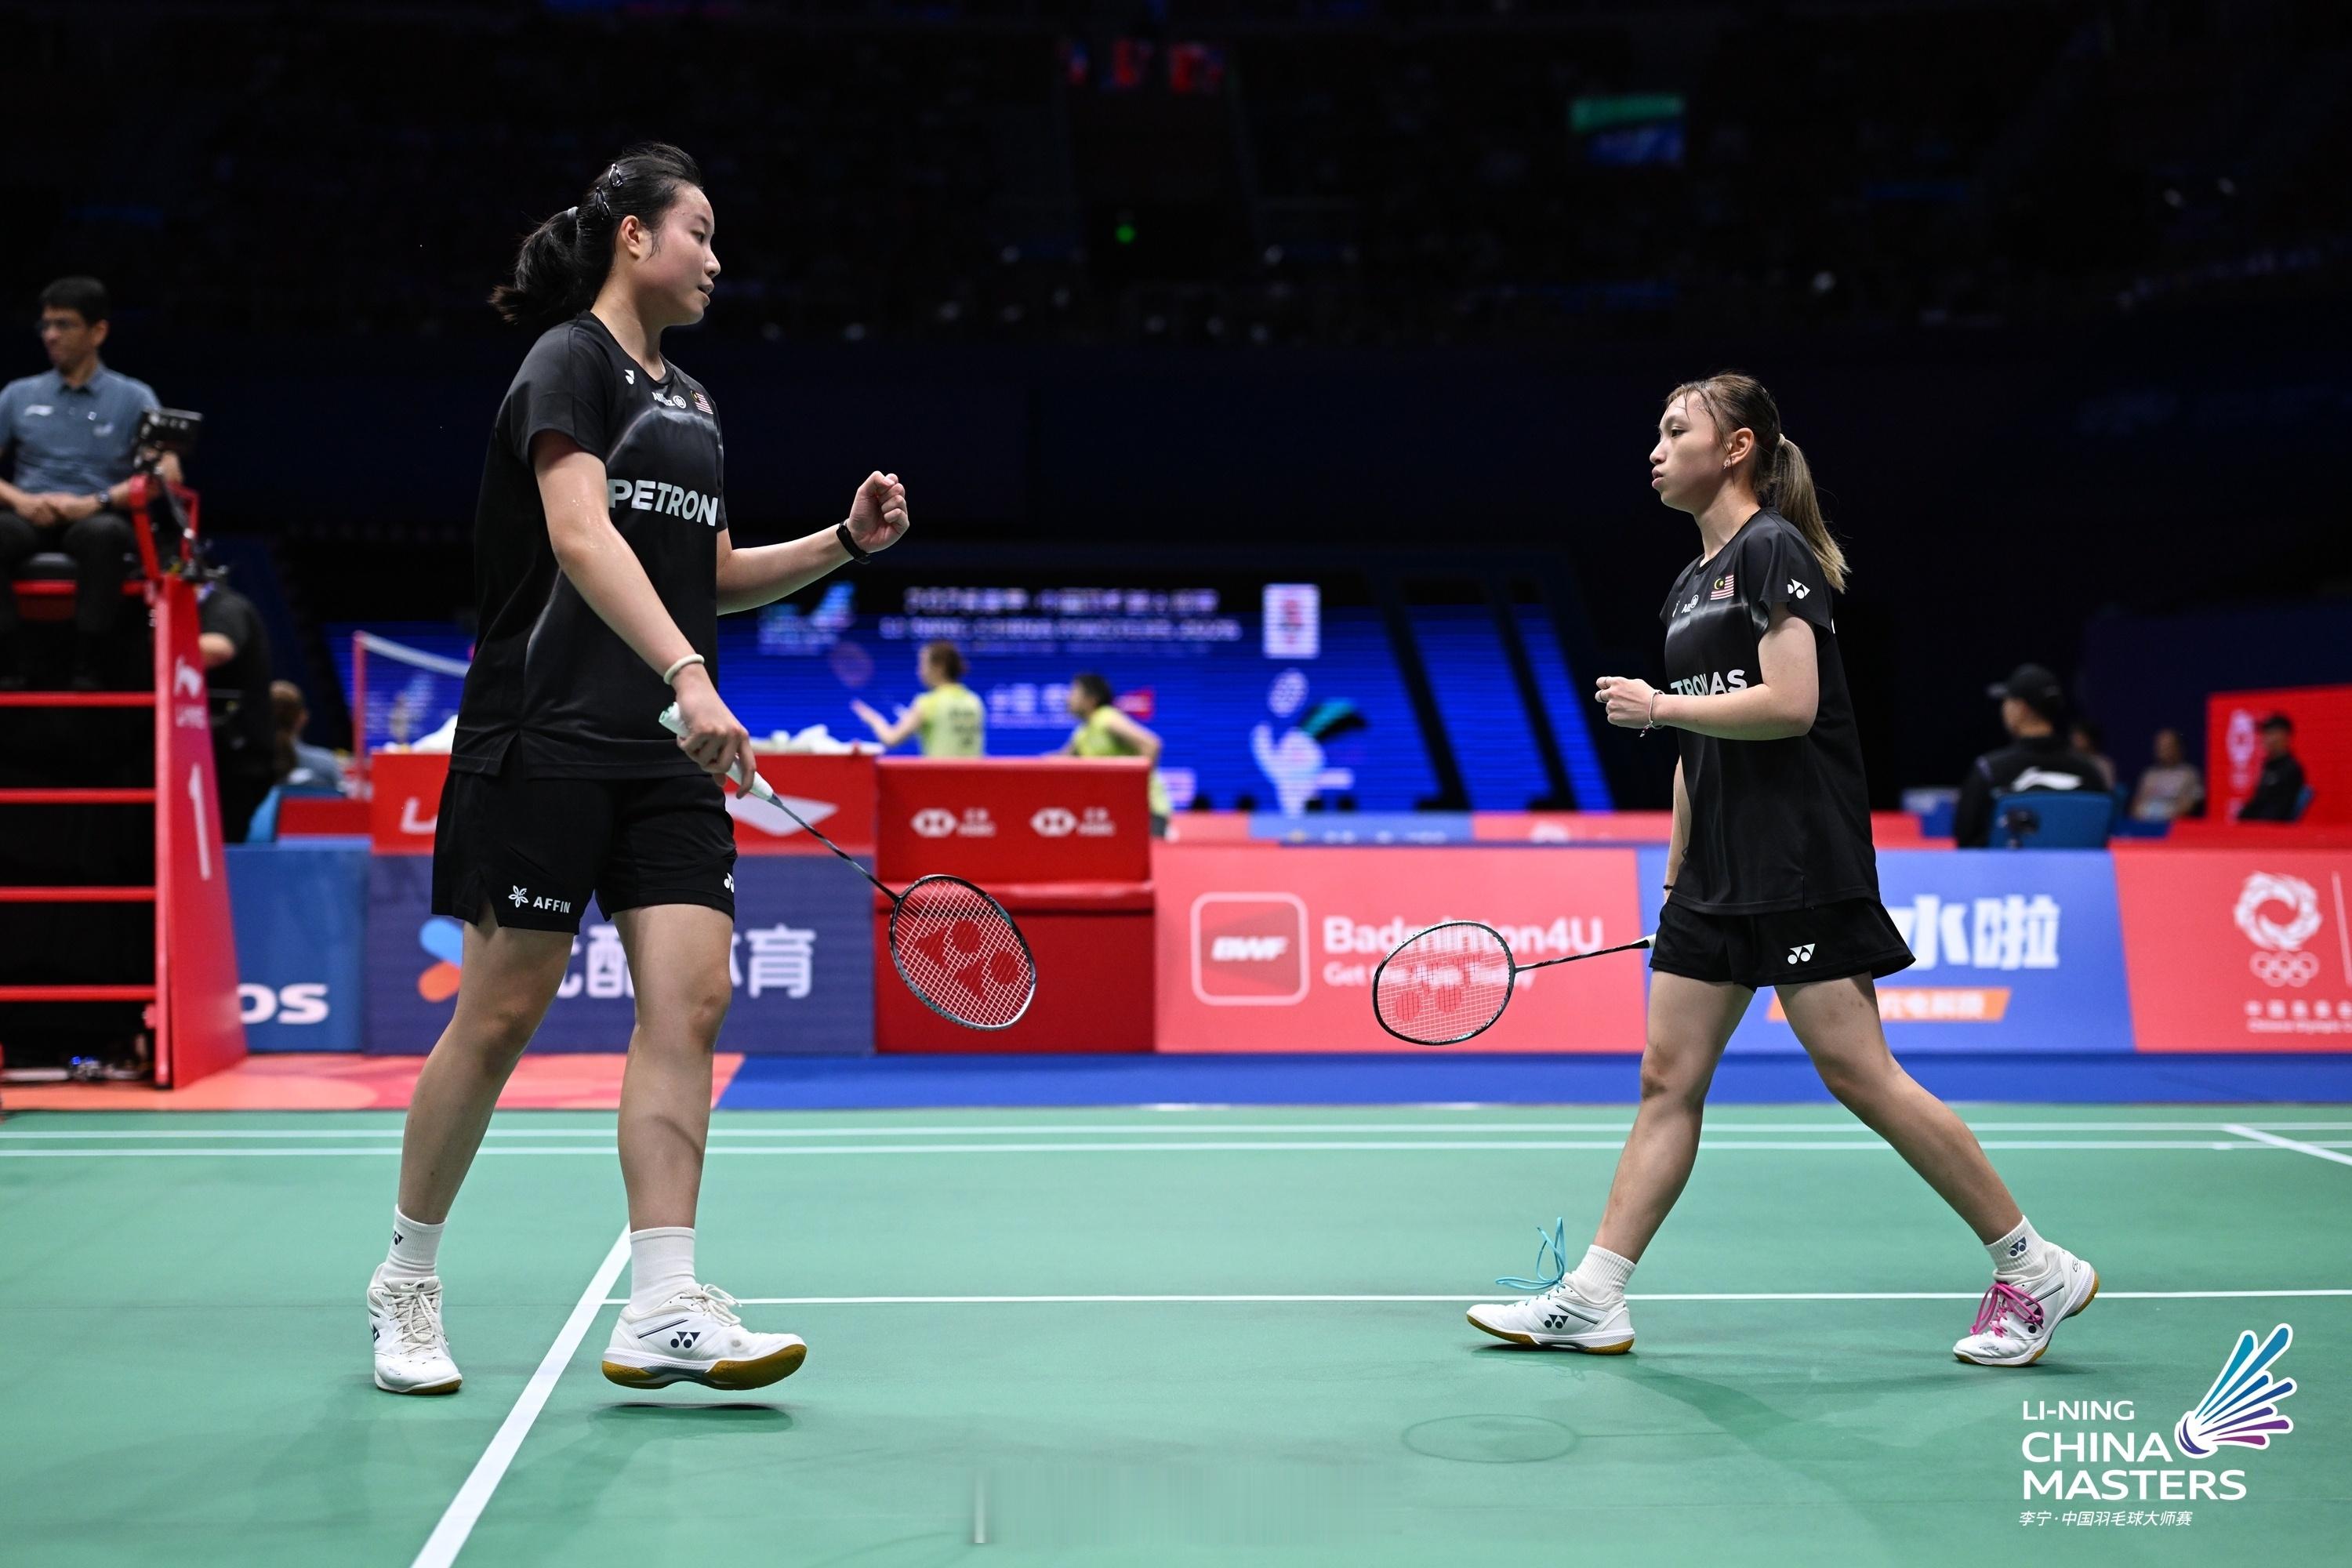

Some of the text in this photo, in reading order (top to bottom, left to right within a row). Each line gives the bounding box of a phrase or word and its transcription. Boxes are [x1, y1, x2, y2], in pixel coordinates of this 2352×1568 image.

[607, 479, 718, 527] PETRON
[1670, 669, 1748, 695] TRONAS
[188, 762, 212, 880] 1
[533, 896, 571, 913] AFFIN
